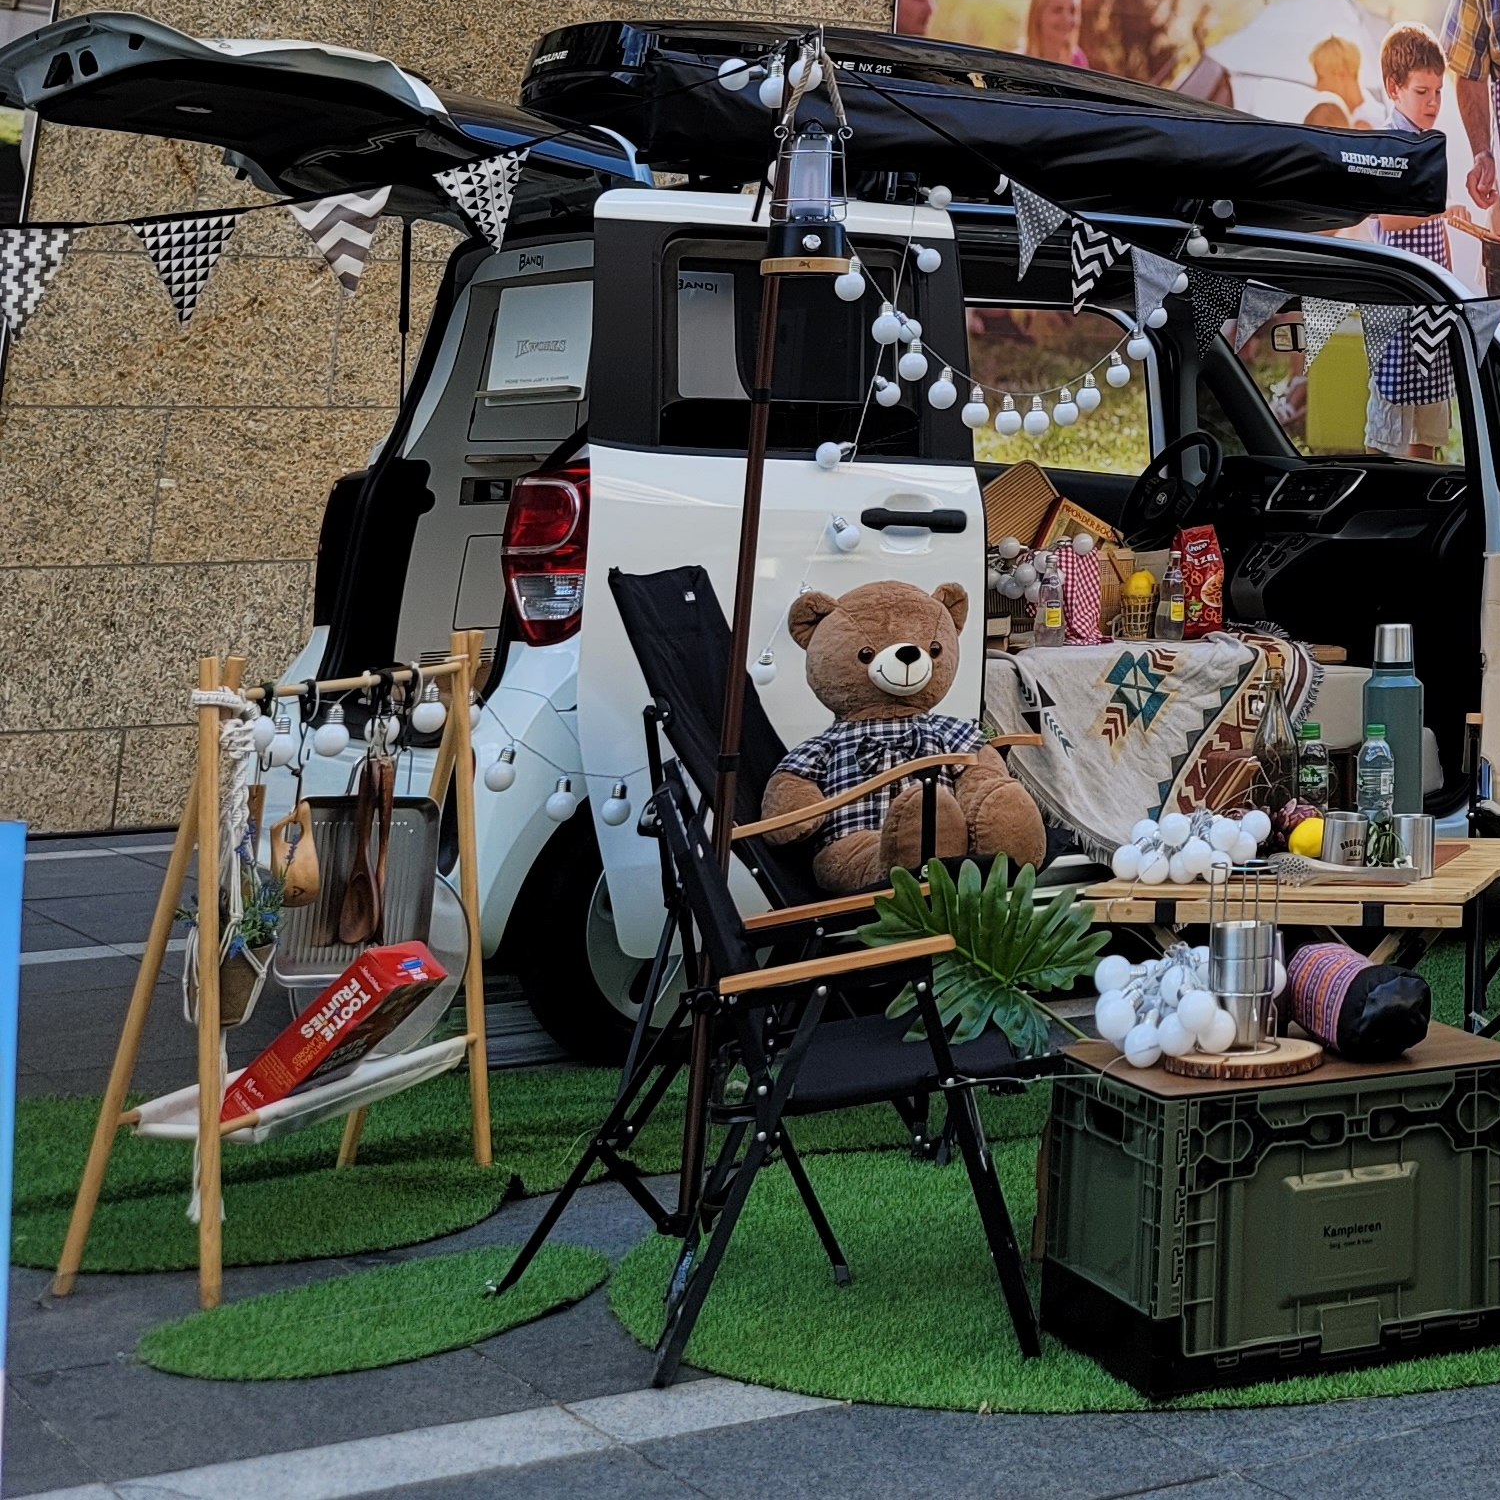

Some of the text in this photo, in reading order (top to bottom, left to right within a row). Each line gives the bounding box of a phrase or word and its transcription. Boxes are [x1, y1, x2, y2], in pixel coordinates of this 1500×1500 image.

[858, 63, 874, 73] NX
[875, 65, 893, 75] 215
[1340, 151, 1410, 170] RHINO-RACK
[519, 254, 545, 272] BANDI
[678, 279, 718, 294] BANDI
